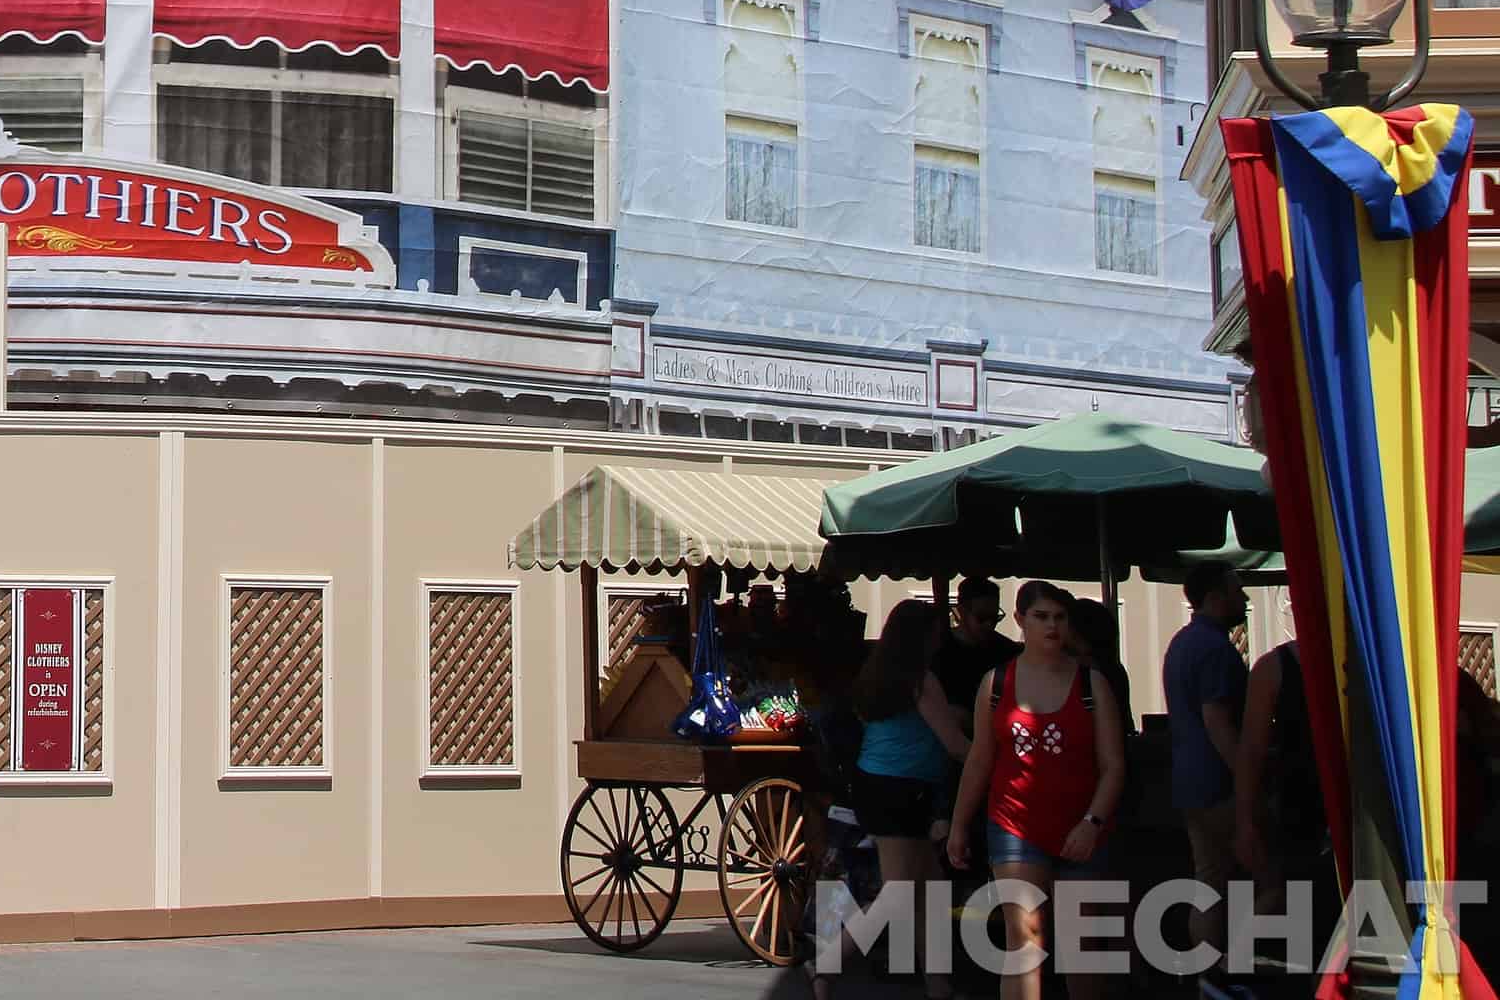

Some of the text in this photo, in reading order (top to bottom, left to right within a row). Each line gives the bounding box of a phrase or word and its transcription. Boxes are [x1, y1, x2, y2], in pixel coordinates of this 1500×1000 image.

[706, 355, 719, 383] &
[765, 361, 813, 395] Clothing
[35, 643, 63, 655] DISNEY
[27, 656, 69, 667] CLOTHIERS
[45, 670, 51, 679] is
[29, 683, 67, 697] OPEN
[38, 699, 58, 709] during
[27, 708, 69, 717] refurbishment
